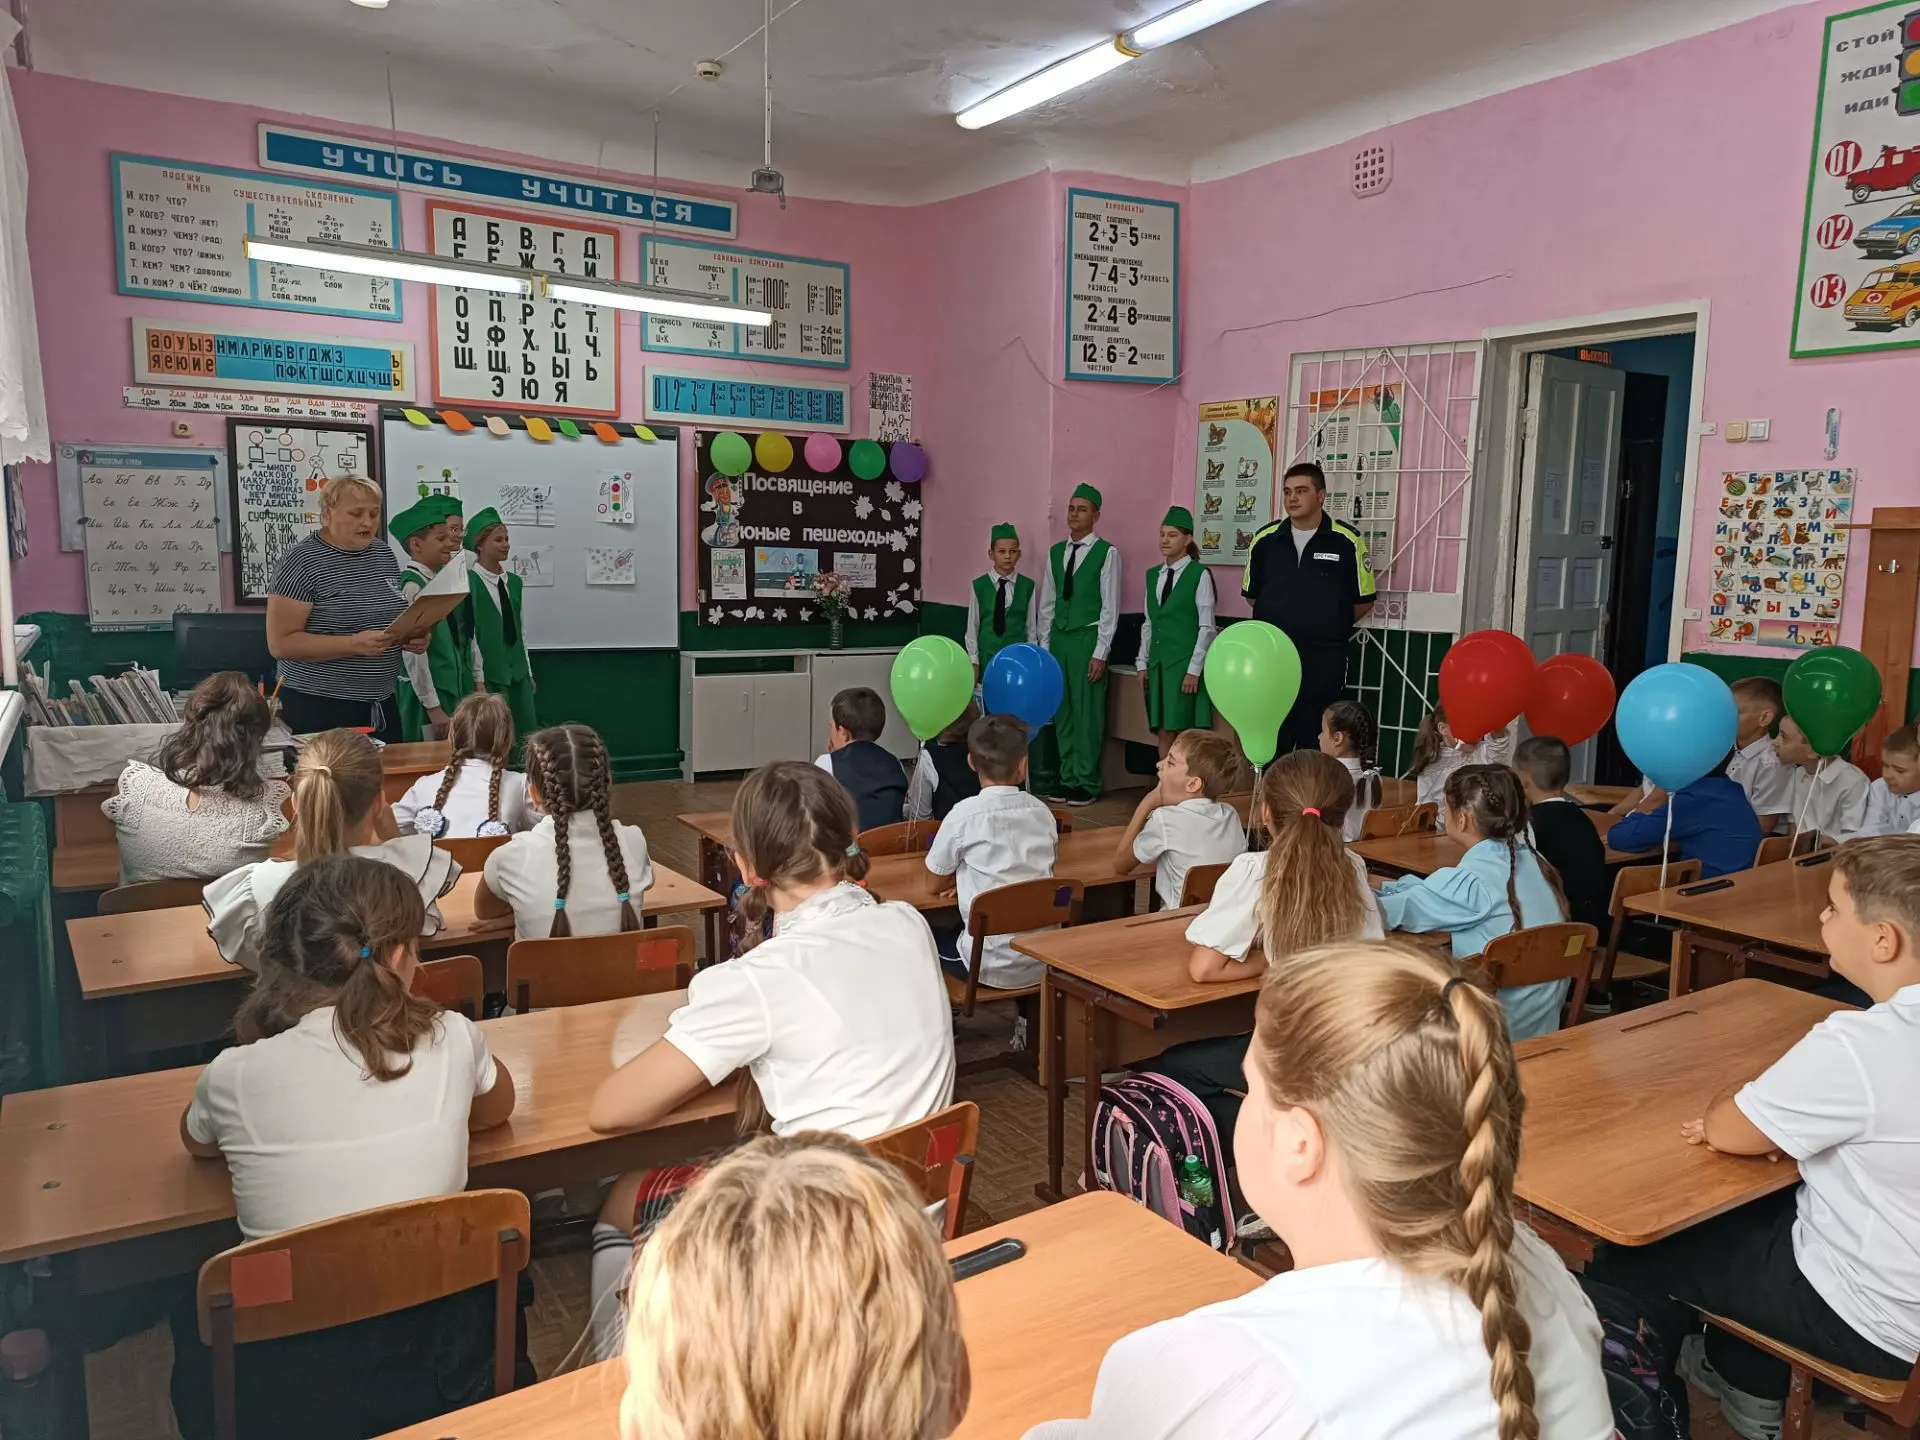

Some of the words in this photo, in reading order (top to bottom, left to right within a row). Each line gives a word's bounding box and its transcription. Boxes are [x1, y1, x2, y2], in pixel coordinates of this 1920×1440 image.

[1835, 27, 1895, 53] СТОЙ
[1840, 61, 1892, 84] ЖДИ
[1844, 94, 1889, 115] ИДИ
[1829, 142, 1857, 175] 01
[322, 146, 462, 186] УЧИСЬ
[522, 178, 692, 222] УЧИТЬСЯ
[139, 193, 160, 202] КТО?
[166, 196, 188, 206] ЧТО?
[305, 190, 355, 205] СКЛОНЕНИЕ
[140, 210, 165, 220] КОГО?
[171, 213, 195, 224] ЧЕГО?
[140, 226, 168, 237] КОМУ?
[173, 231, 199, 241] ЧЕМУ?
[453, 217, 466, 241] А
[1820, 215, 1849, 248] 02
[141, 243, 166, 253] КОГО?
[172, 247, 193, 257] ЧТО?
[142, 261, 163, 271] КЕМ?
[170, 263, 190, 273] ЧЕМ?
[152, 279, 174, 289] КОМ?
[1813, 274, 1844, 307] 03
[763, 276, 785, 310] 1000
[821, 325, 832, 335] 24
[821, 335, 832, 355] 60
[492, 375, 504, 397] Э
[521, 378, 539, 400] Ю
[554, 382, 568, 403] Я
[240, 476, 264, 485] КАК?
[252, 471, 293, 479] ЛАСКОВО
[272, 486, 303, 494] ПРИКАЗ
[743, 472, 853, 497] Посвящение
[244, 498, 262, 506] ЧТО
[269, 492, 297, 500] МНОГО
[802, 528, 892, 547] пешеходы
